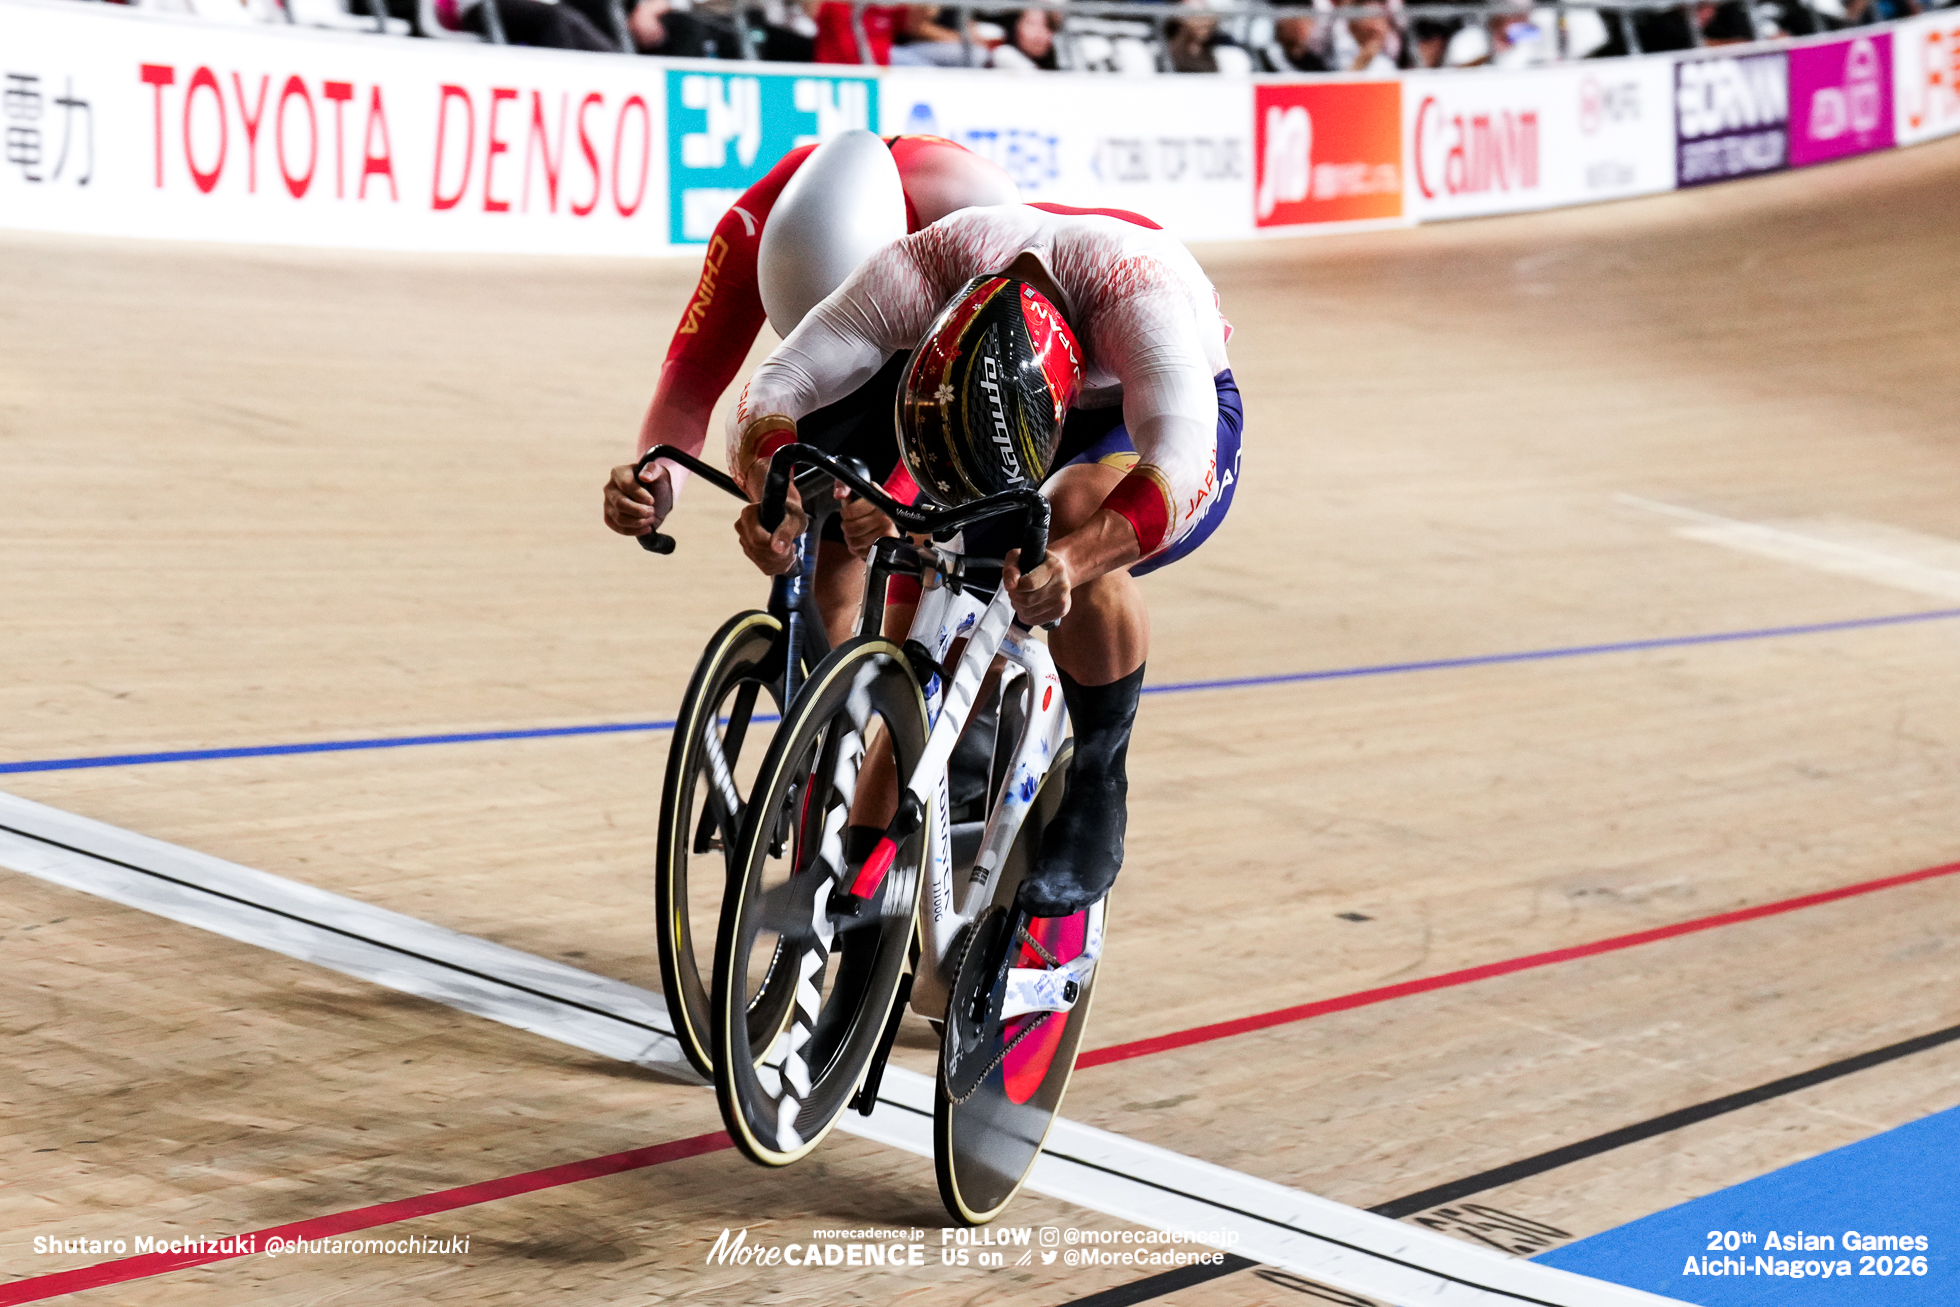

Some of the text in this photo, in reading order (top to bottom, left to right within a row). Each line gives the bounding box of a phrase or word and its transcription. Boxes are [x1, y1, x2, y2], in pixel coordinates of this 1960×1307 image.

[4, 73, 95, 186] 電力
[140, 62, 652, 218] TOYOTA DENSO
[1414, 95, 1539, 199] Canon
[679, 234, 729, 334] CHINA
[1030, 300, 1081, 381] JAPAN
[980, 356, 1025, 484] kabuto
